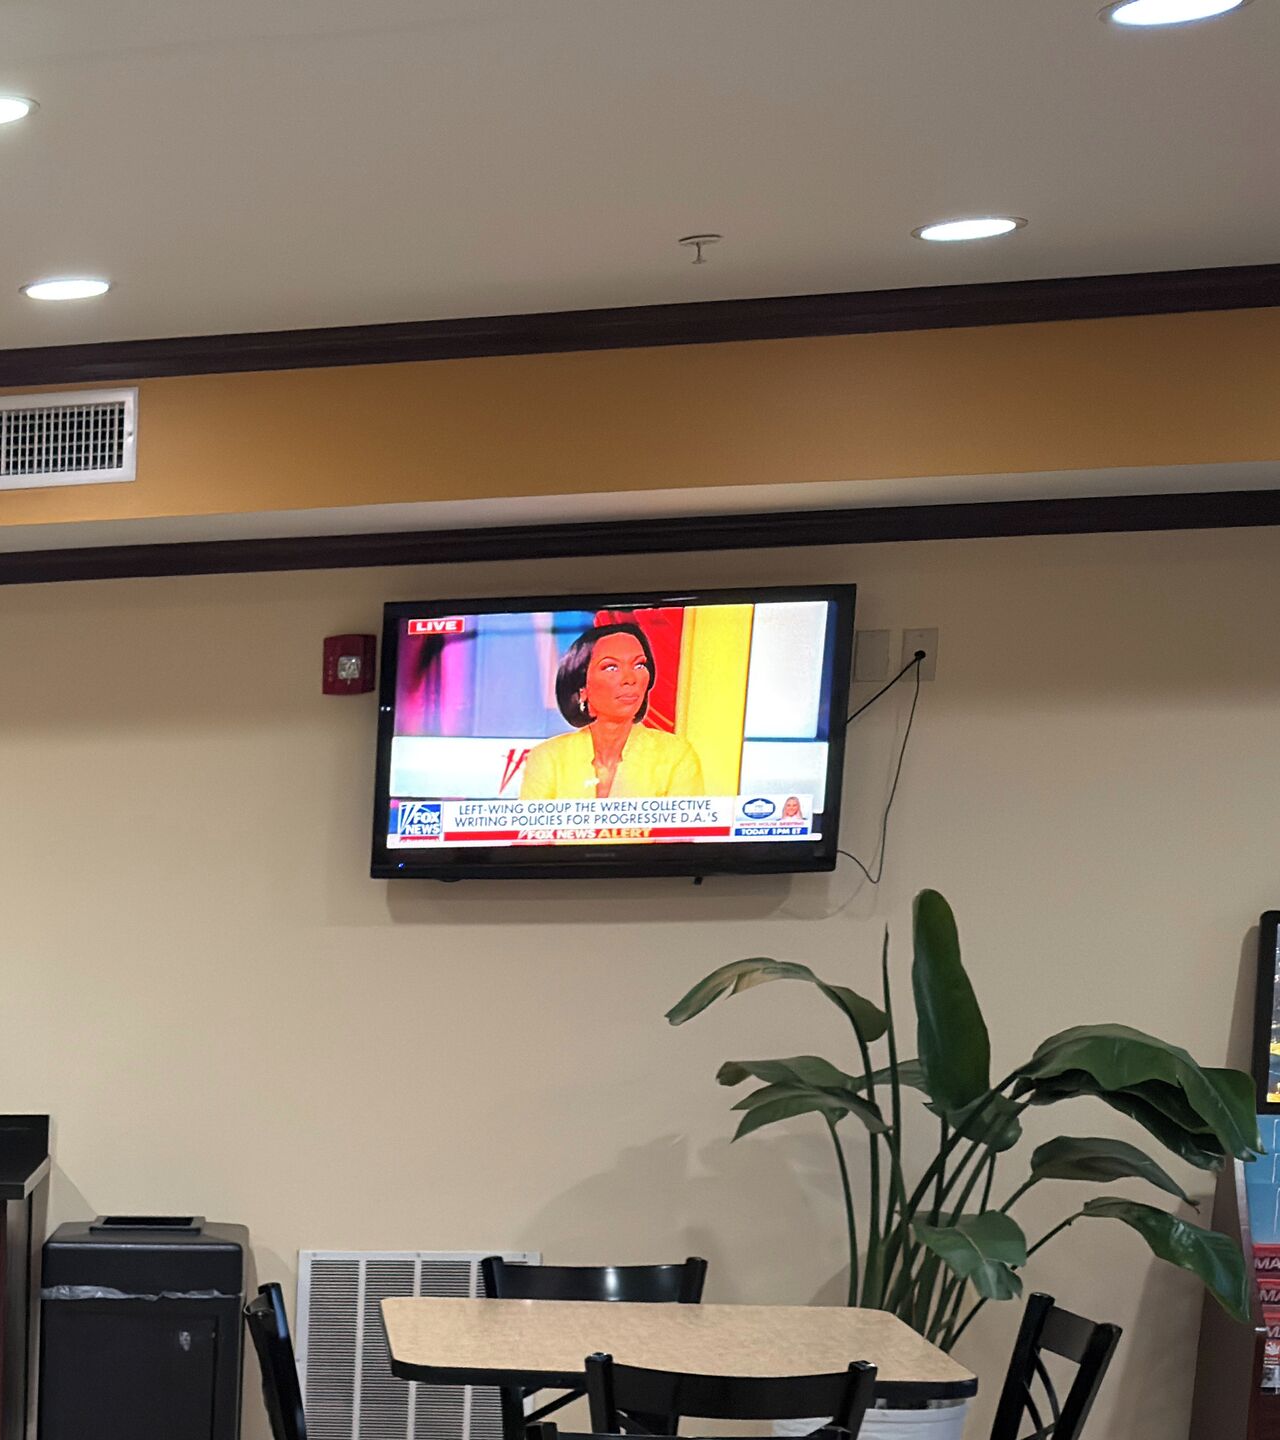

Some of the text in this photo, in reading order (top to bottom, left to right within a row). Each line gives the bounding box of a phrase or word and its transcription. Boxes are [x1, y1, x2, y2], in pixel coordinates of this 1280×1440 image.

[416, 620, 457, 632] LIVE
[459, 800, 711, 816] LEFT-WING GROUP THE WREN COLLECTIVE
[413, 812, 440, 824] FOX
[455, 812, 718, 827] WRITING POLICIES FOR PROGRESSIVE D.A.'S
[405, 824, 440, 835] NEWS
[526, 828, 652, 840] FOX NEWS ALERT
